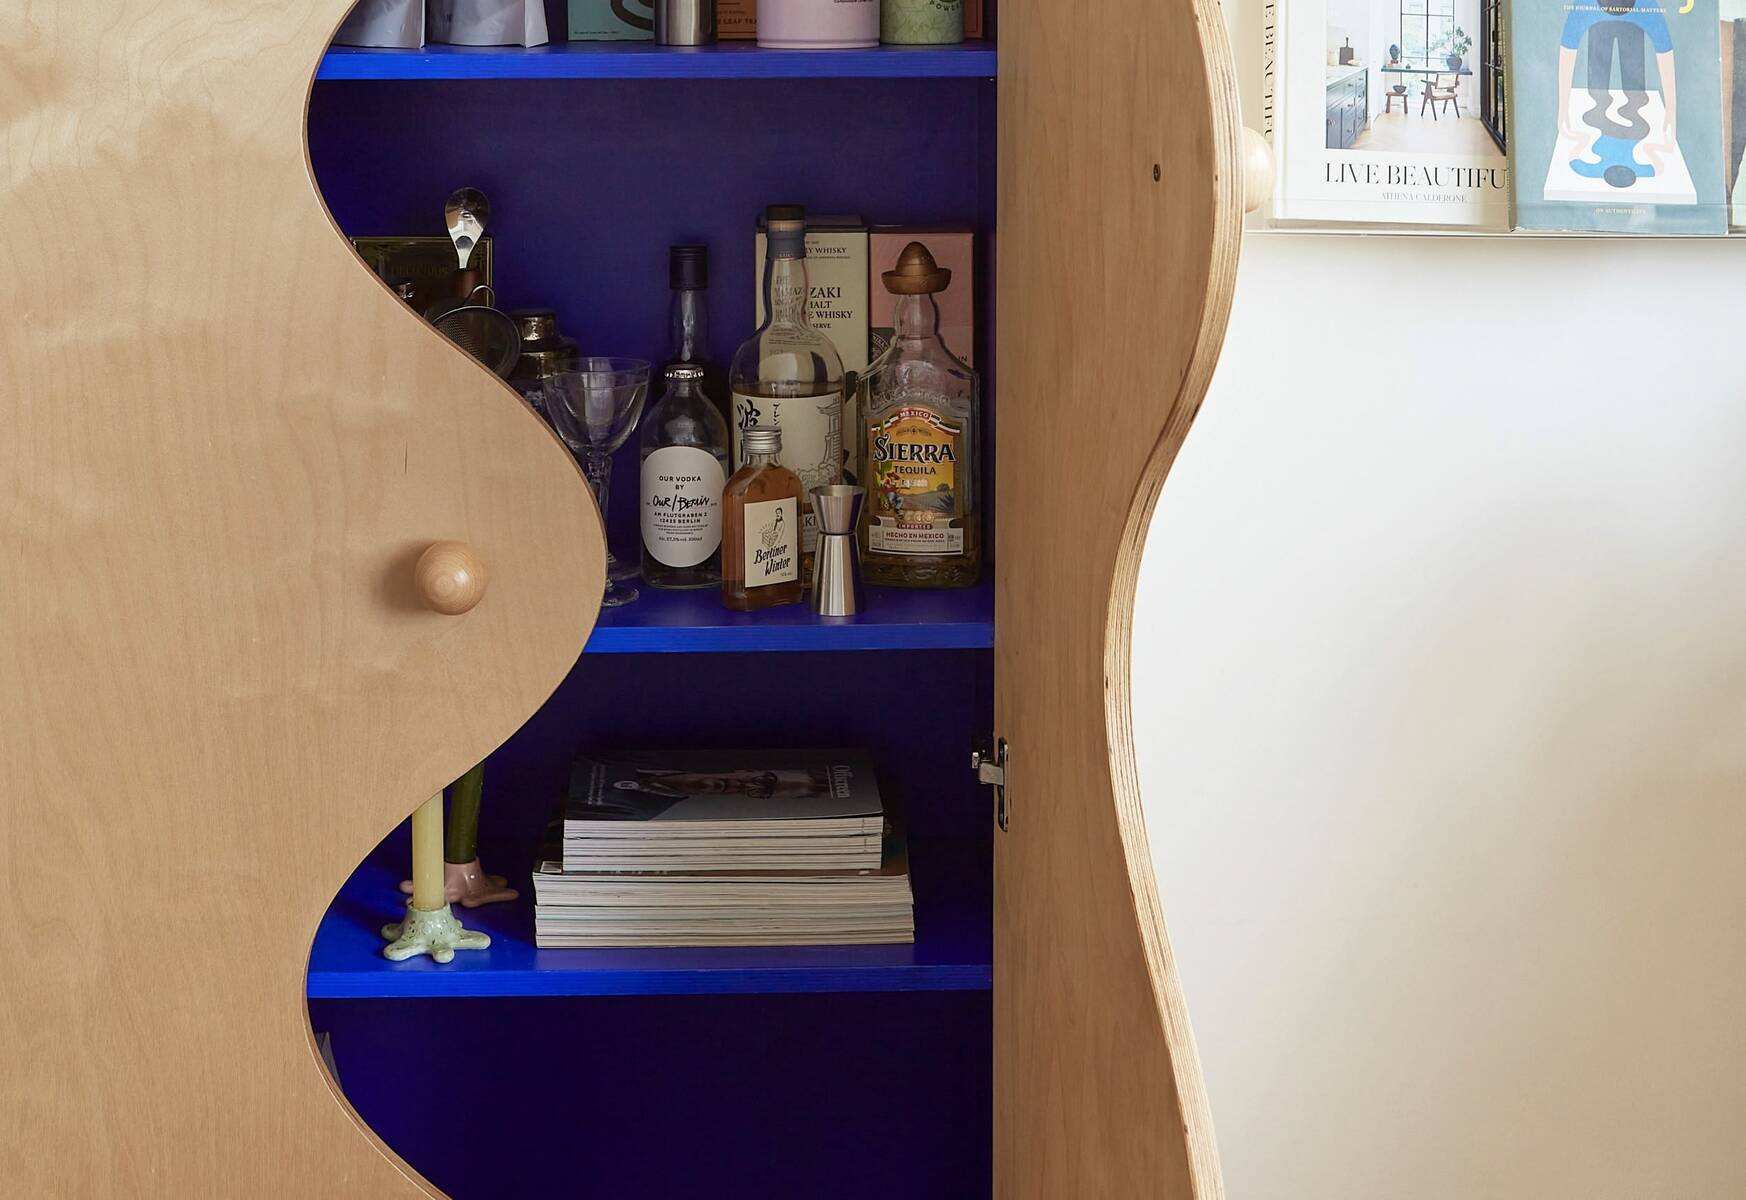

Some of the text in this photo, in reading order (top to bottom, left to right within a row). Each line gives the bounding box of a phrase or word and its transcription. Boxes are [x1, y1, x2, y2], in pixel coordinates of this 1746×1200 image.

[1326, 162, 1380, 185] LIVE
[815, 311, 853, 319] WHISKY
[899, 409, 930, 418] MEXICO
[874, 433, 957, 464] SIERRA
[893, 465, 937, 475] TEQUILA
[885, 531, 908, 539] HECHO
[918, 532, 945, 540] MEXICO
[753, 544, 788, 565] Berliner
[765, 557, 791, 577] Winter
